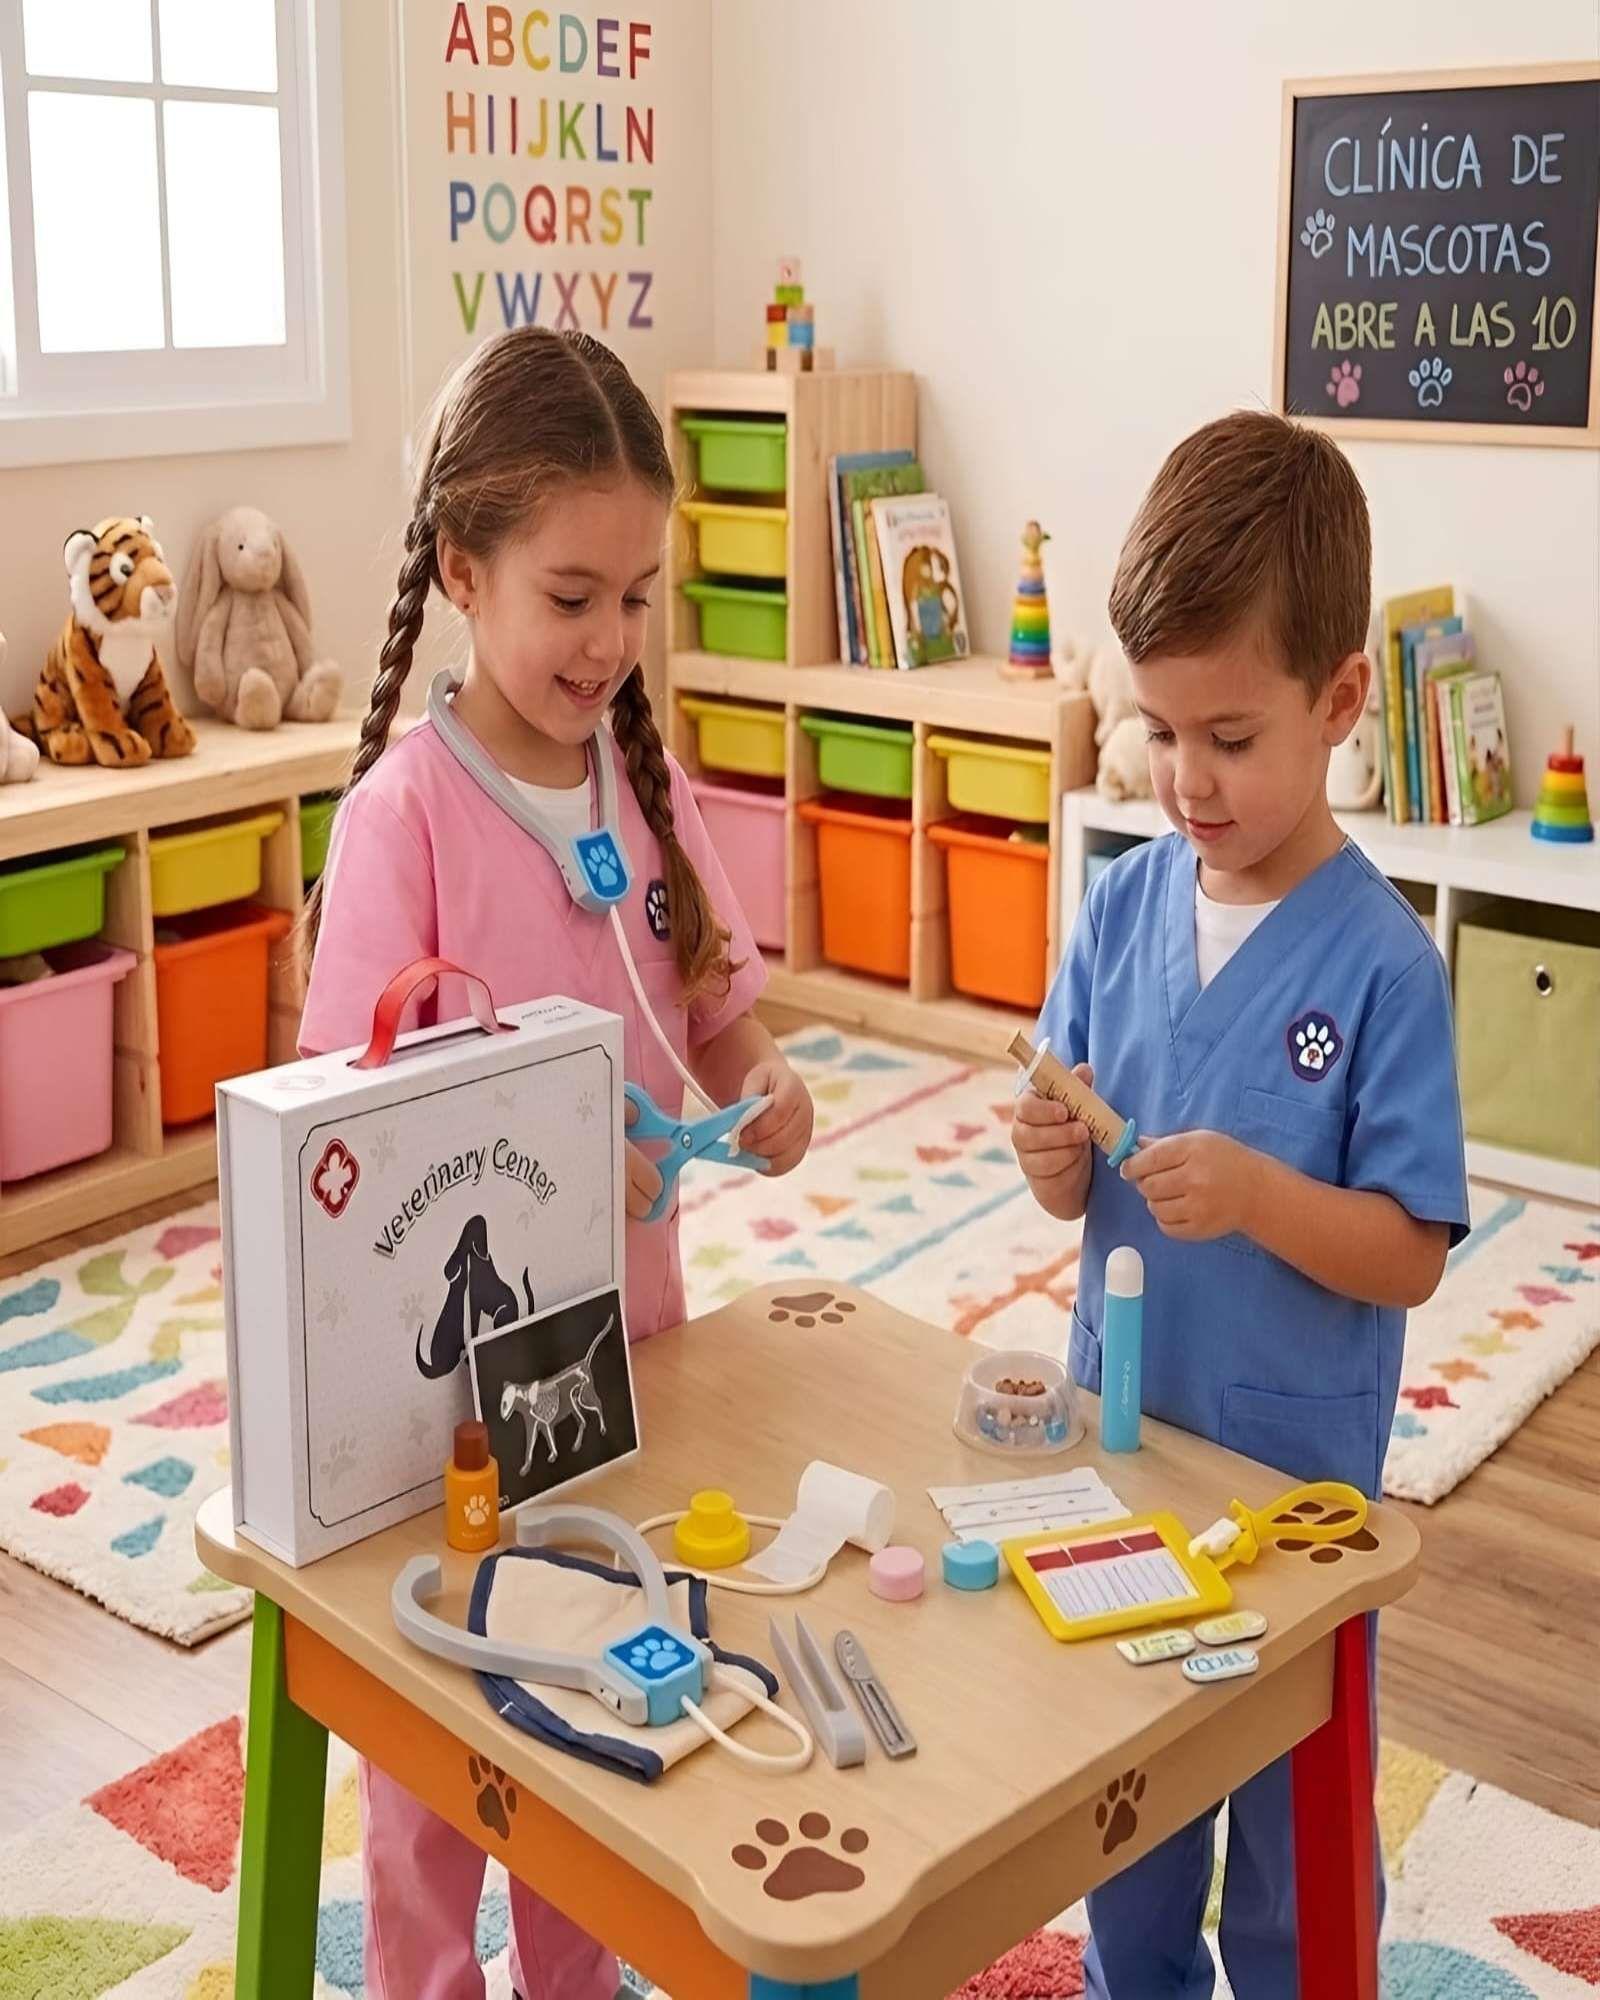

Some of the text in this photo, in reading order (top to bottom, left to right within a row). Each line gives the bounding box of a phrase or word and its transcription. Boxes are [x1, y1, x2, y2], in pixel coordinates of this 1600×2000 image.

[1510, 133, 1565, 185] DE
[1347, 220, 1551, 278] MASCOTAS
[1311, 296, 1577, 351] ABRE A LAS 10
[373, 1146, 487, 1259] Veterinary
